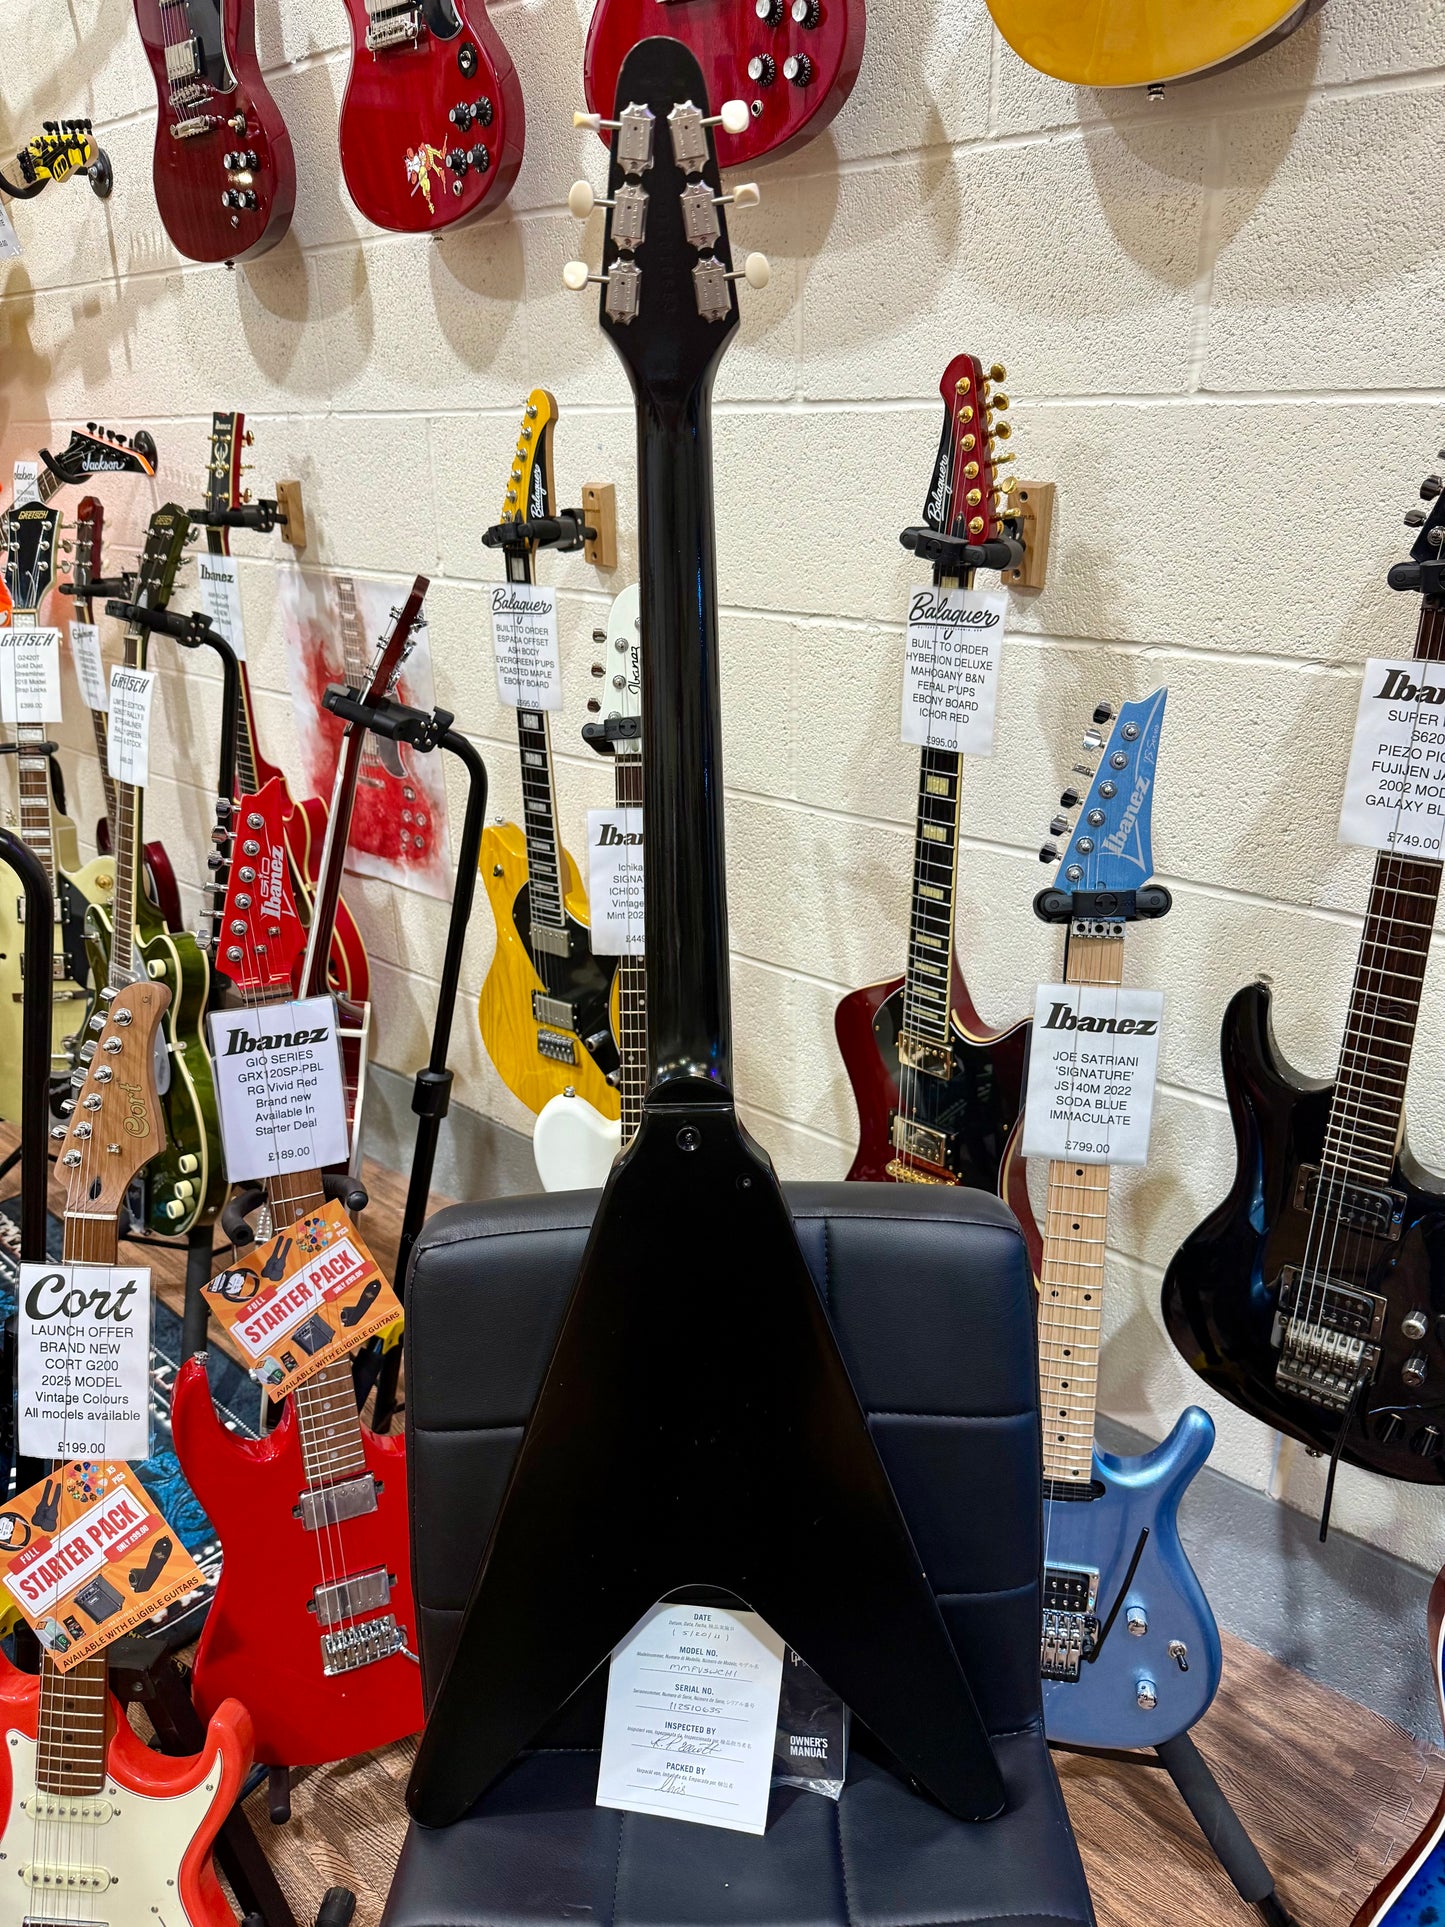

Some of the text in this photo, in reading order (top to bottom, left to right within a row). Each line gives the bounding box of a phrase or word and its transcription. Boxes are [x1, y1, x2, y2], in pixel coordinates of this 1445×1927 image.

[82, 452, 125, 471] Jackson
[530, 463, 547, 518] Balaguer
[927, 455, 952, 522] Balaguer
[18, 510, 49, 520] GRETSCH
[200, 564, 235, 584] Ibanez
[492, 588, 553, 624] Balaguer
[909, 592, 1000, 640] Balaguer
[496, 624, 514, 633] BUILT
[525, 626, 549, 636] ORDER
[1, 633, 56, 647] GRETSCH
[524, 637, 549, 647] OFFSET
[911, 638, 989, 657] BUILT TO ORDER
[496, 655, 534, 667] EVERGREEN
[905, 655, 994, 672] HYBERION DELUXE
[499, 666, 552, 679] ROASTED MAPLE
[910, 666, 986, 684] MAHOGANY B&N
[112, 673, 150, 694] GRETSCH
[504, 677, 550, 689] EBONY BOARD
[917, 681, 946, 694] FERAL
[912, 694, 979, 711] EBONY BOARD
[919, 708, 970, 724] ICHOR RED
[1387, 710, 1440, 727] SUPER
[926, 735, 958, 750] £995.00
[1378, 744, 1423, 762] PIEZO
[1371, 763, 1430, 780] FUJIJEN
[1378, 781, 1412, 796] 2002
[1365, 795, 1424, 813] GALAXY
[1101, 776, 1150, 858] Ibanez
[1387, 832, 1441, 850] £749.00
[260, 845, 284, 921] Ibanez
[612, 875, 645, 884] SIGNA
[607, 911, 645, 920] Mint 202
[1040, 1002, 1159, 1036] Ibanez
[222, 1027, 330, 1058] Ibanez
[245, 1050, 314, 1069] GIO SERIES
[1052, 1050, 1139, 1068] JOE SATRIANI
[237, 1062, 324, 1084] GRX120SP-PBL
[246, 1077, 318, 1097] RG Vivid Red
[1054, 1081, 1132, 1097] JS140M 2022
[255, 1092, 312, 1109] Brand new
[1056, 1096, 1128, 1112] SODA BLUE
[119, 1082, 150, 1139] Cort
[255, 1104, 315, 1123] Available In
[1049, 1109, 1132, 1126] IMMACULATE
[255, 1117, 318, 1137] Starter Deal
[268, 1145, 310, 1163] £189.00
[1064, 1140, 1111, 1155] £799.00
[25, 1273, 138, 1322] Cort
[244, 1249, 356, 1344] STARTER PACK
[246, 1295, 267, 1314] FULL
[31, 1325, 134, 1338] LAUNCH OFFER
[40, 1341, 121, 1355] BRAND NEW
[276, 1311, 401, 1399] AVAILABLE WITH ELIGIBLE GUITARS
[45, 1358, 119, 1372] CORT G200
[41, 1375, 123, 1388] 2025 MODEL
[35, 1391, 130, 1406] Vintage Colours
[24, 1407, 141, 1422] All models available
[57, 1441, 106, 1455] £199.00
[19, 1500, 140, 1601] STARTER PACK
[115, 1538, 132, 1553] ONLY
[19, 1547, 41, 1565] FULL
[62, 1633, 107, 1668] AVAILABLE
[106, 1620, 130, 1640] WITH
[128, 1600, 165, 1626] ELIGIBLE
[164, 1576, 200, 1603] GUITARS
[694, 1613, 713, 1622] DATE
[679, 1646, 719, 1658] MODEL NO.
[674, 1683, 715, 1696] SERIAL NO.
[664, 1720, 717, 1736] INSPECTED BY
[790, 1735, 829, 1749] OWNER'S
[790, 1745, 828, 1759] MANUAL
[666, 1761, 706, 1776] PACKED BY
